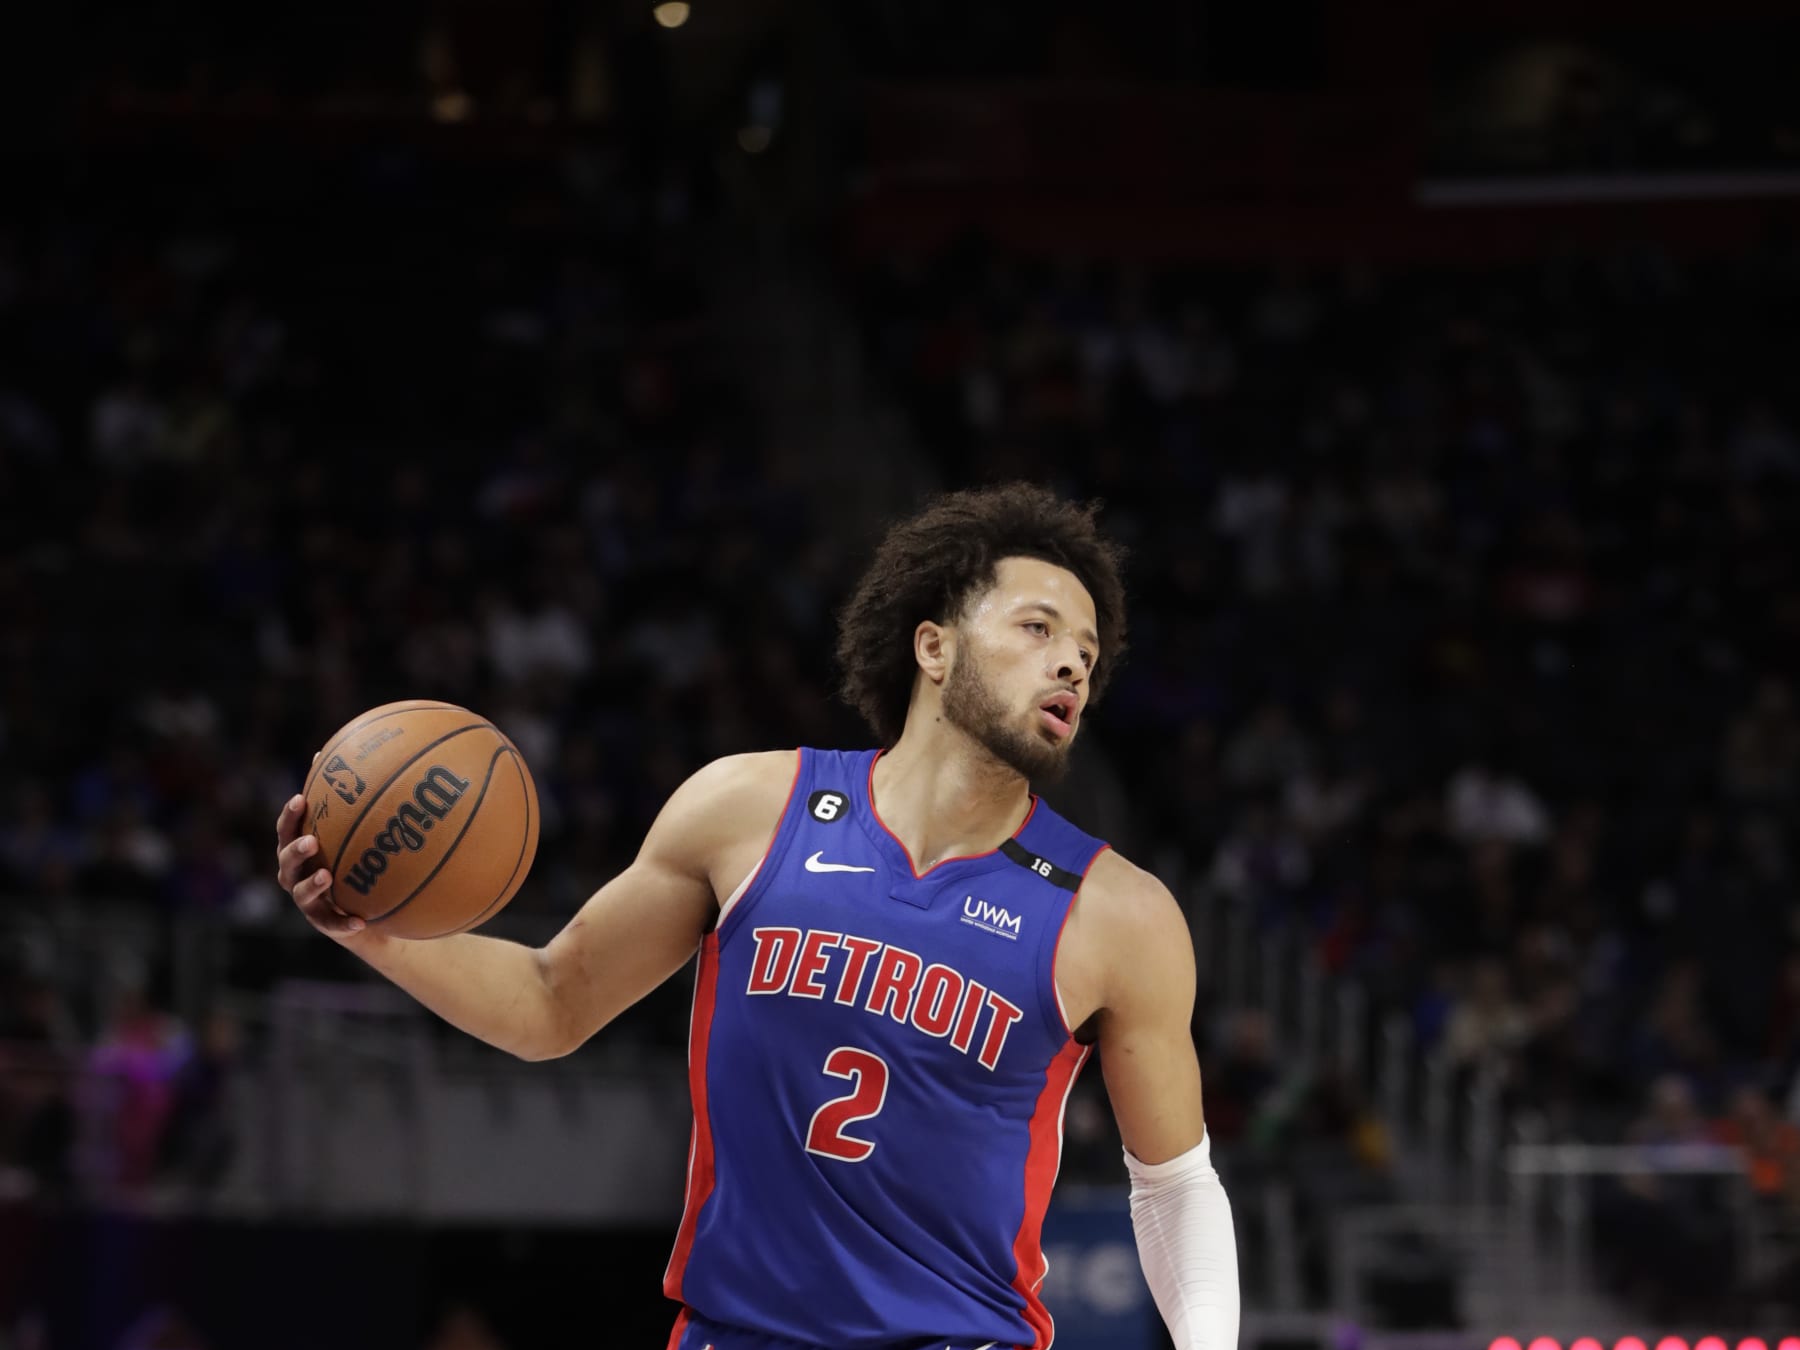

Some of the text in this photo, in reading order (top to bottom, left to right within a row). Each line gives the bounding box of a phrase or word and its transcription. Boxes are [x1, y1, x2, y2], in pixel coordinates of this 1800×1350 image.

[344, 765, 470, 895] Wilson
[814, 794, 842, 819] 6
[1031, 857, 1052, 877] 16
[964, 896, 1022, 934] UWM
[746, 927, 1023, 1072] DETROIT
[805, 1047, 889, 1162] 2
